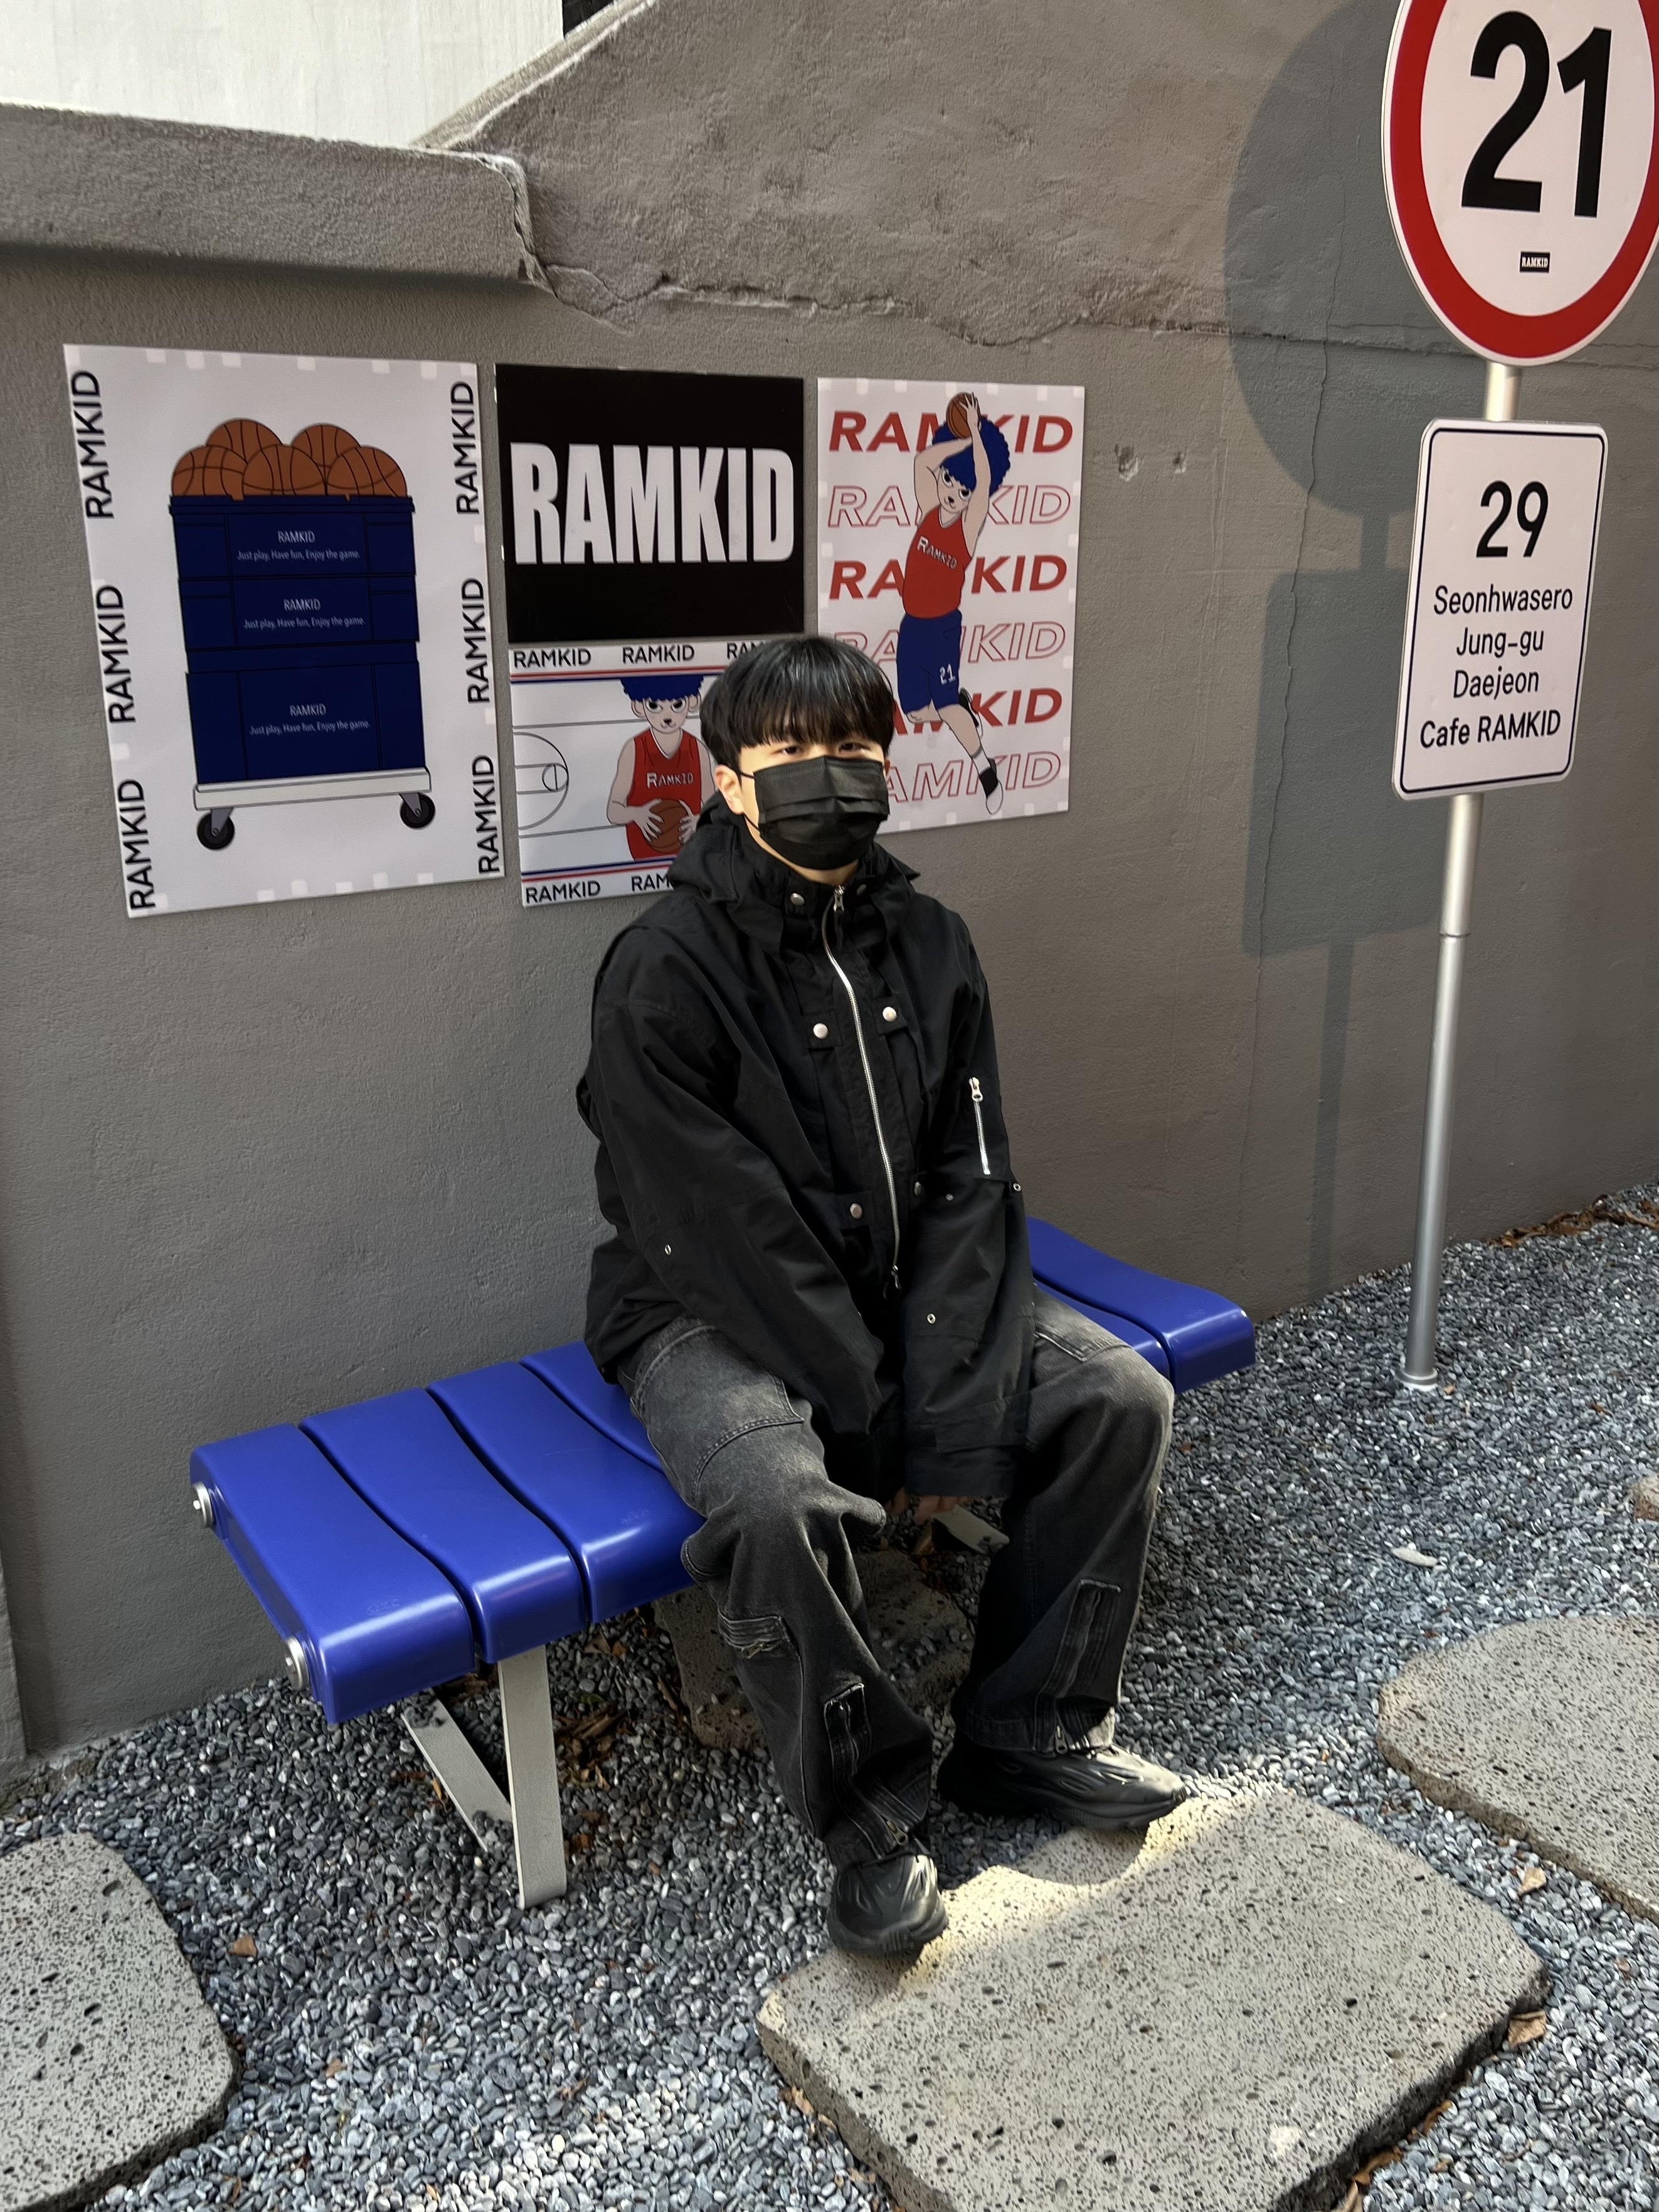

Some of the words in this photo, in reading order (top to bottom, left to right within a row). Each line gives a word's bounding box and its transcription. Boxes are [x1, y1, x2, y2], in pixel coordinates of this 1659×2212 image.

[1461, 11, 1613, 218] 21
[1522, 257, 1548, 269] RAMKID
[71, 371, 114, 519] RAMKID
[451, 381, 480, 515] RAMKID
[829, 410, 1074, 454] RAID
[509, 441, 795, 565] RAMKID
[827, 485, 1071, 528] RAKID
[1476, 481, 1549, 558] 29
[277, 529, 315, 543] RAMKID
[237, 550, 253, 560] Just
[271, 550, 290, 560] Have
[305, 550, 324, 561] Enjoy
[326, 549, 337, 559] the
[829, 554, 1068, 601] RAKID
[283, 598, 321, 612] RAMKID
[1434, 584, 1574, 615] Seonhwasero
[243, 619, 258, 629] Just
[277, 617, 295, 627] Have
[310, 617, 330, 628] Enjoy
[331, 616, 343, 625] the
[97, 585, 137, 724] RAMKID
[461, 577, 492, 704] RAMKID
[513, 647, 592, 669] RAMKID
[622, 644, 696, 665] RAMKID
[1456, 627, 1544, 659] Jung-gu
[940, 663, 956, 685] 21
[1454, 666, 1540, 701] Daejeon
[289, 703, 327, 717] RAMKID
[250, 725, 265, 736] Just
[283, 723, 301, 733] Have
[316, 721, 336, 732] Enjoy
[337, 720, 349, 730] the
[1421, 718, 1471, 749] Cafe
[1478, 710, 1562, 743] RAMKID
[647, 772, 694, 789] RAMKID
[472, 755, 501, 875] RAMKID
[118, 779, 156, 910] RAMKID
[525, 880, 602, 904] RAMKID
